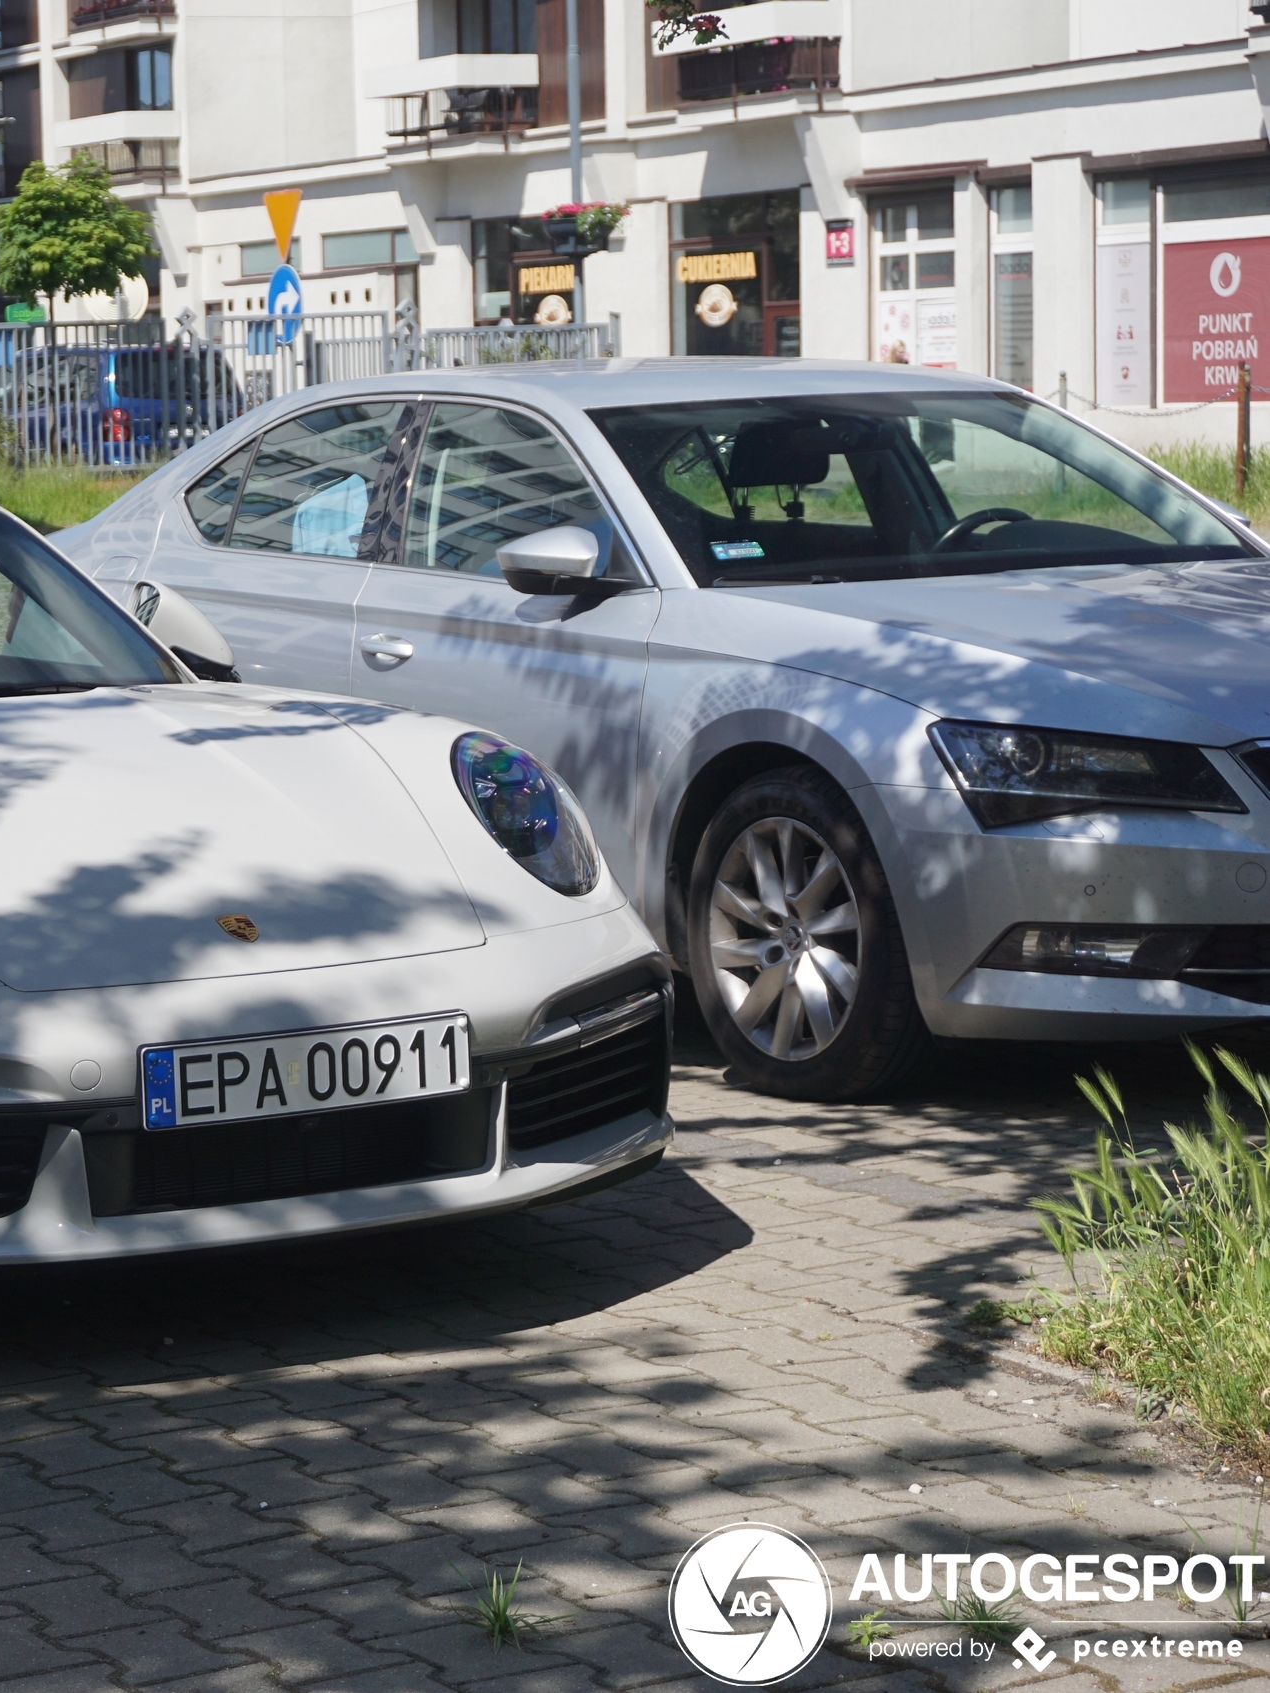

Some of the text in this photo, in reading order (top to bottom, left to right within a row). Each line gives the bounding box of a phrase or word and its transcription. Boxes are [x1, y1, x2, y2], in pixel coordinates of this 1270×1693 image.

[829, 232, 850, 254] 1-3
[676, 251, 757, 283] CUKIERNIA
[1199, 312, 1253, 334] PUNKT
[1192, 335, 1258, 360] POBRAŃ
[179, 1025, 457, 1117] EPA 00911
[151, 1098, 172, 1115] PL
